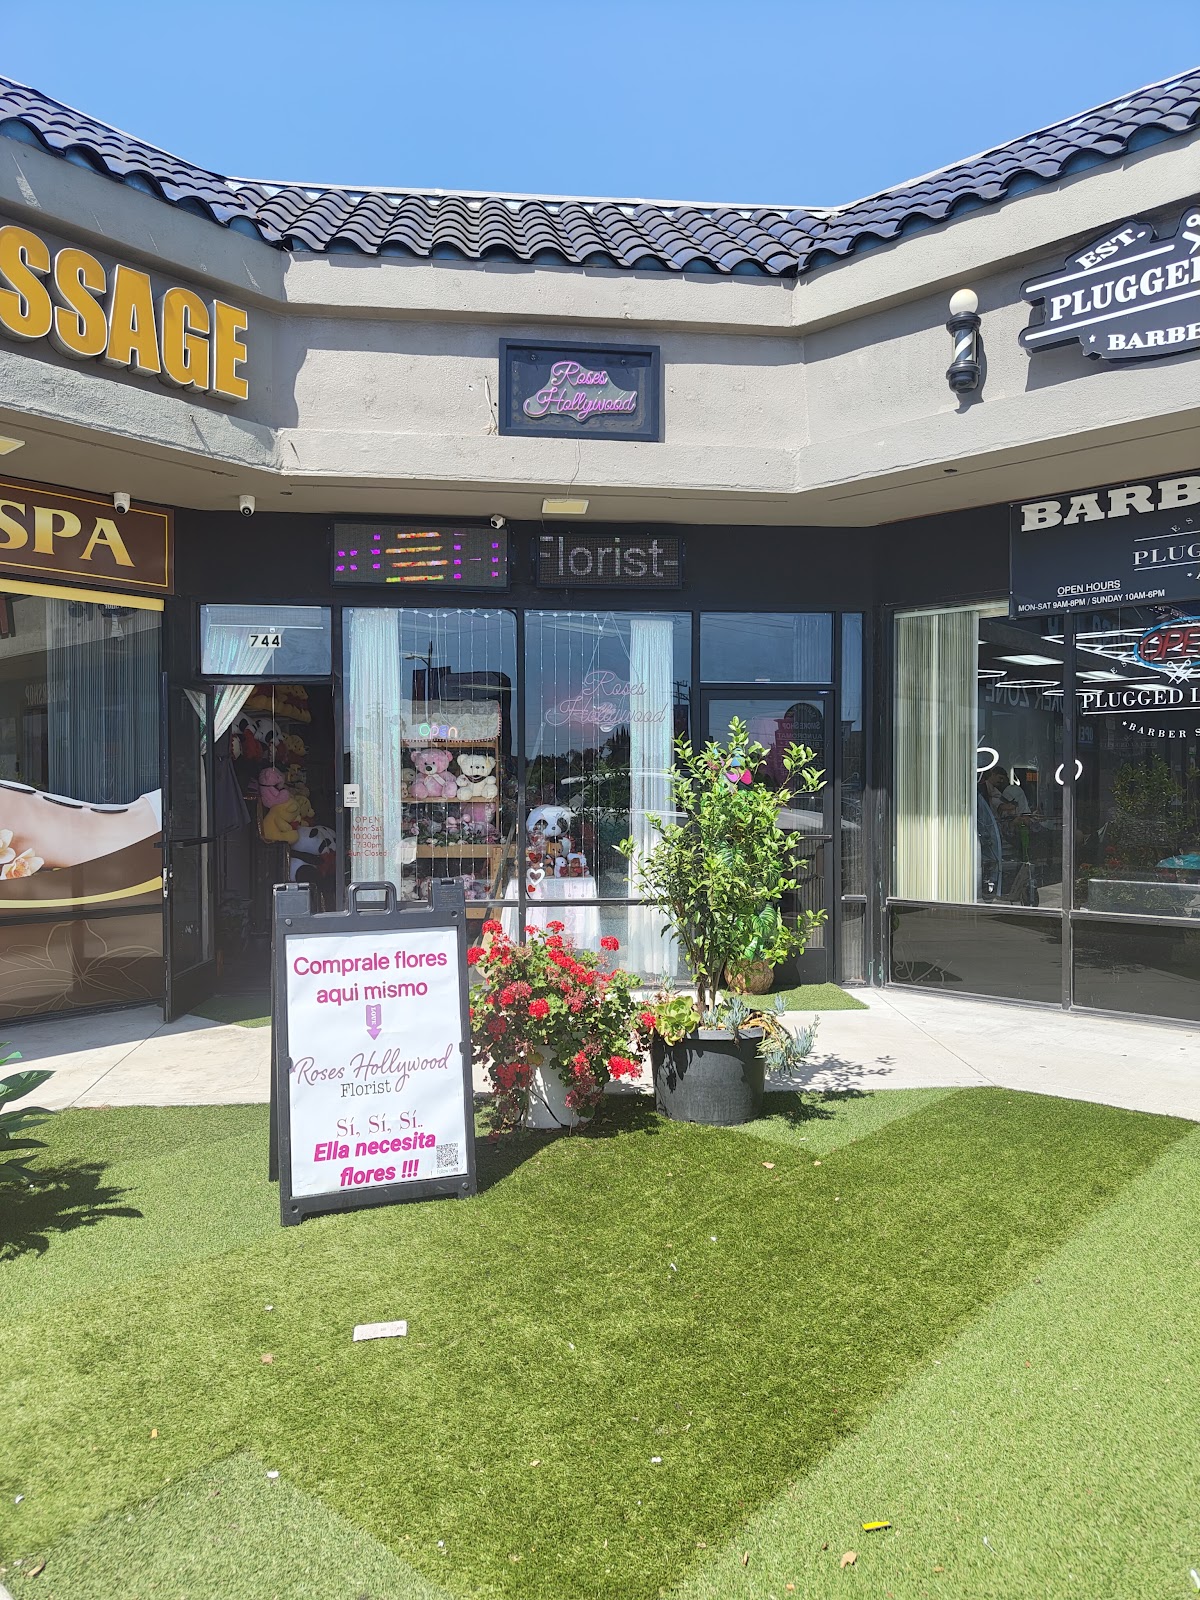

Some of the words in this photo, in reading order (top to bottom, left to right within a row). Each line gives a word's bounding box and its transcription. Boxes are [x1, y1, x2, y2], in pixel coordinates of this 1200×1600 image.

[1075, 227, 1146, 270] EST.
[0, 225, 249, 400] SSAGE
[551, 360, 608, 386] Roses
[524, 387, 638, 420] Hollywood
[1021, 475, 1200, 532] BARB
[0, 499, 136, 568] SPA
[1018, 601, 1051, 612] MON-SAT
[1052, 598, 1086, 609] 9AM-8PM
[1091, 594, 1124, 605] SUNDAY
[1125, 589, 1166, 601] 10AM-6PM
[1057, 583, 1084, 596] OPEN
[1086, 579, 1121, 593] HOURS
[250, 635, 280, 647] 744
[583, 670, 648, 696] Roses
[1082, 687, 1184, 709] PLUGGED
[1128, 722, 1187, 739] BARBER
[355, 816, 381, 824] OPEN
[293, 952, 390, 977] Comprale
[394, 951, 448, 970] flores
[316, 982, 359, 1006] aqui
[363, 981, 428, 1000] mismo
[293, 1056, 345, 1086] Roses
[349, 1043, 454, 1093] Hollywood
[340, 1079, 392, 1098] Florist
[336, 1116, 361, 1139] Sí,
[367, 1112, 392, 1135] Sí,
[313, 1139, 350, 1162] Ella
[354, 1131, 437, 1158] necesita
[340, 1165, 396, 1187] flores
[402, 1158, 420, 1179] !!!
